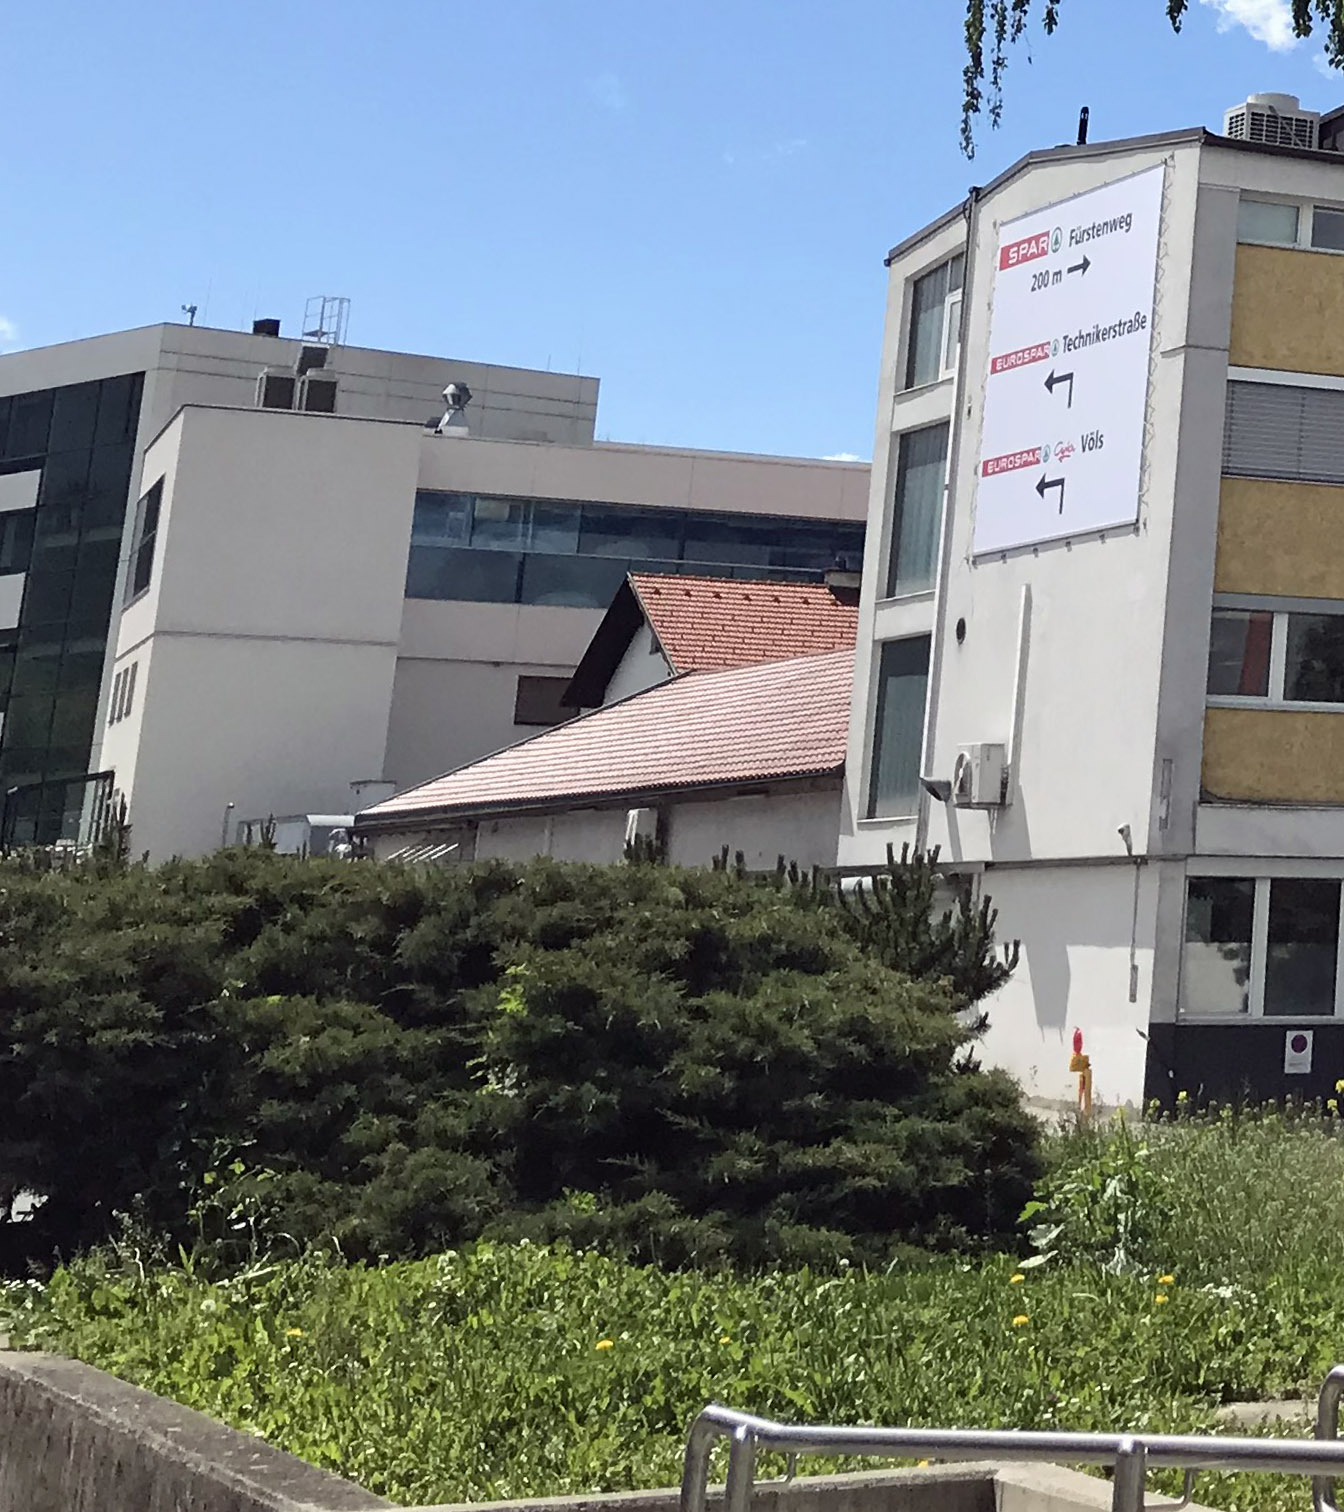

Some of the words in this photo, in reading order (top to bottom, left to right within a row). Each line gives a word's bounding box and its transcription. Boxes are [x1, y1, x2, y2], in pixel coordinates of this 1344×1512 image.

[1008, 236, 1049, 264] SPAR
[1069, 213, 1133, 247] Fürstenweg
[1031, 271, 1050, 292] 200
[1052, 269, 1063, 285] m
[996, 344, 1050, 370] EUROSPAR
[1062, 311, 1147, 353] Technikerstraße
[987, 449, 1041, 474] EUROSPAR
[1081, 429, 1104, 453] Völs
